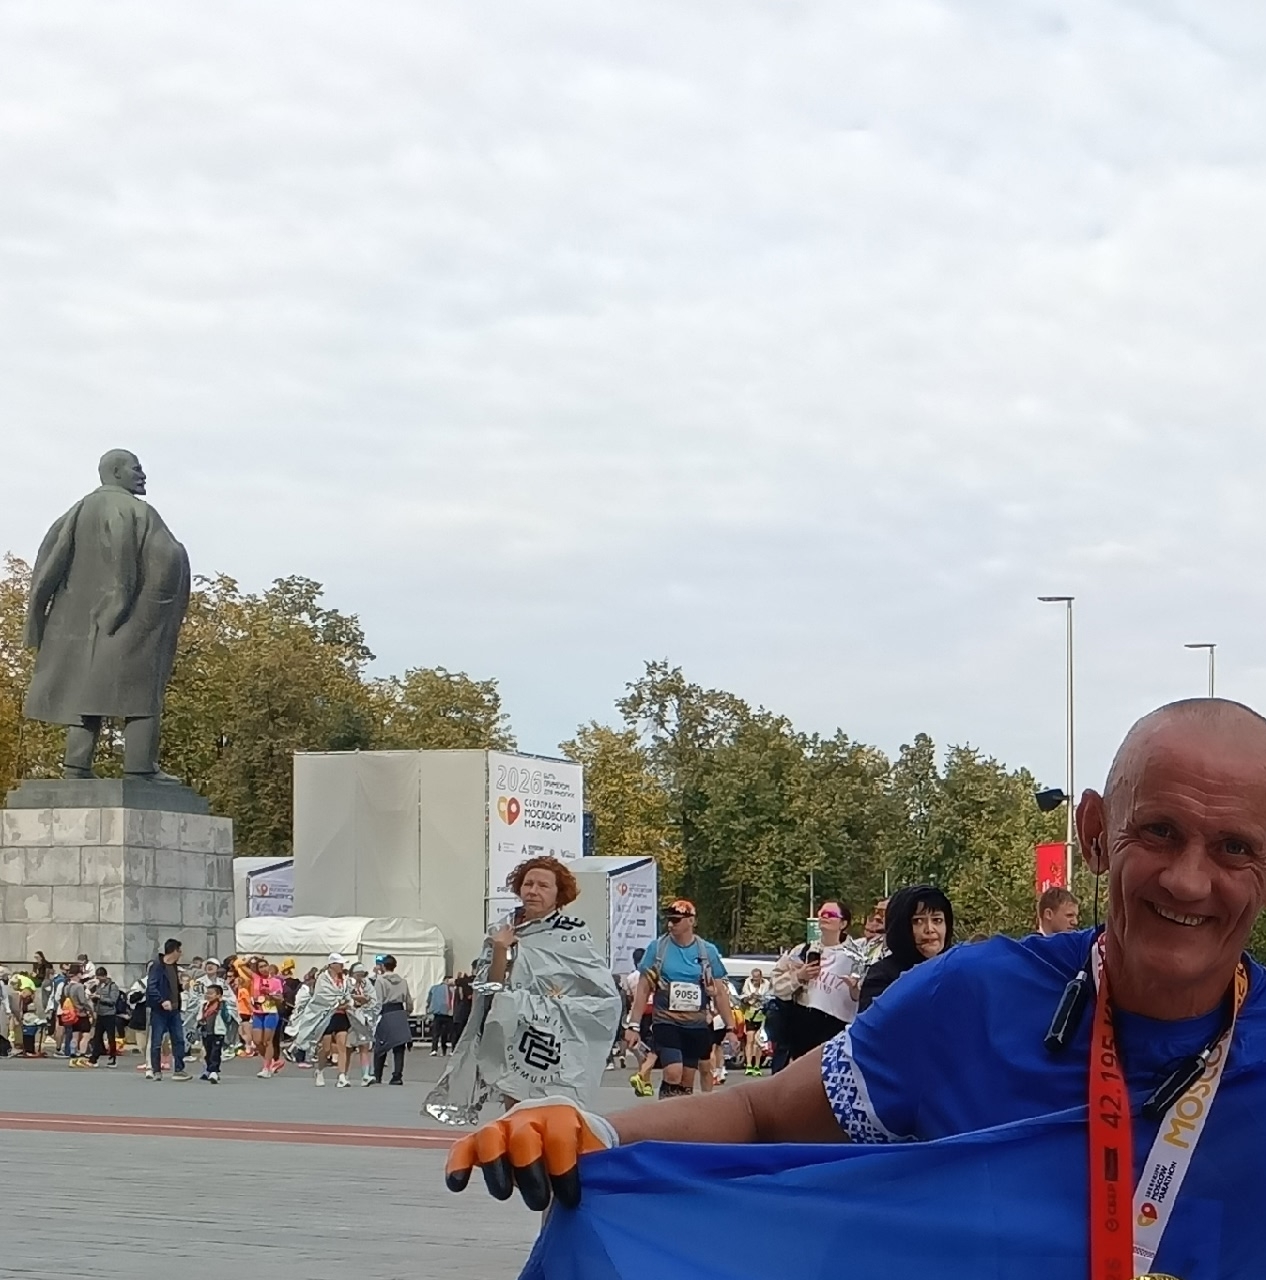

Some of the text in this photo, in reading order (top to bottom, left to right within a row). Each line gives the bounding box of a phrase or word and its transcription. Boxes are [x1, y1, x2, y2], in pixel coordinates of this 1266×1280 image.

[496, 764, 542, 795] 2026
[524, 809, 576, 823] МОСКОВСКИЙ
[524, 820, 562, 832] МАРАФОН
[674, 989, 699, 1000] 9055
[1151, 1165, 1168, 1201] MOSCOW
[1158, 1160, 1177, 1203] MARATHON
